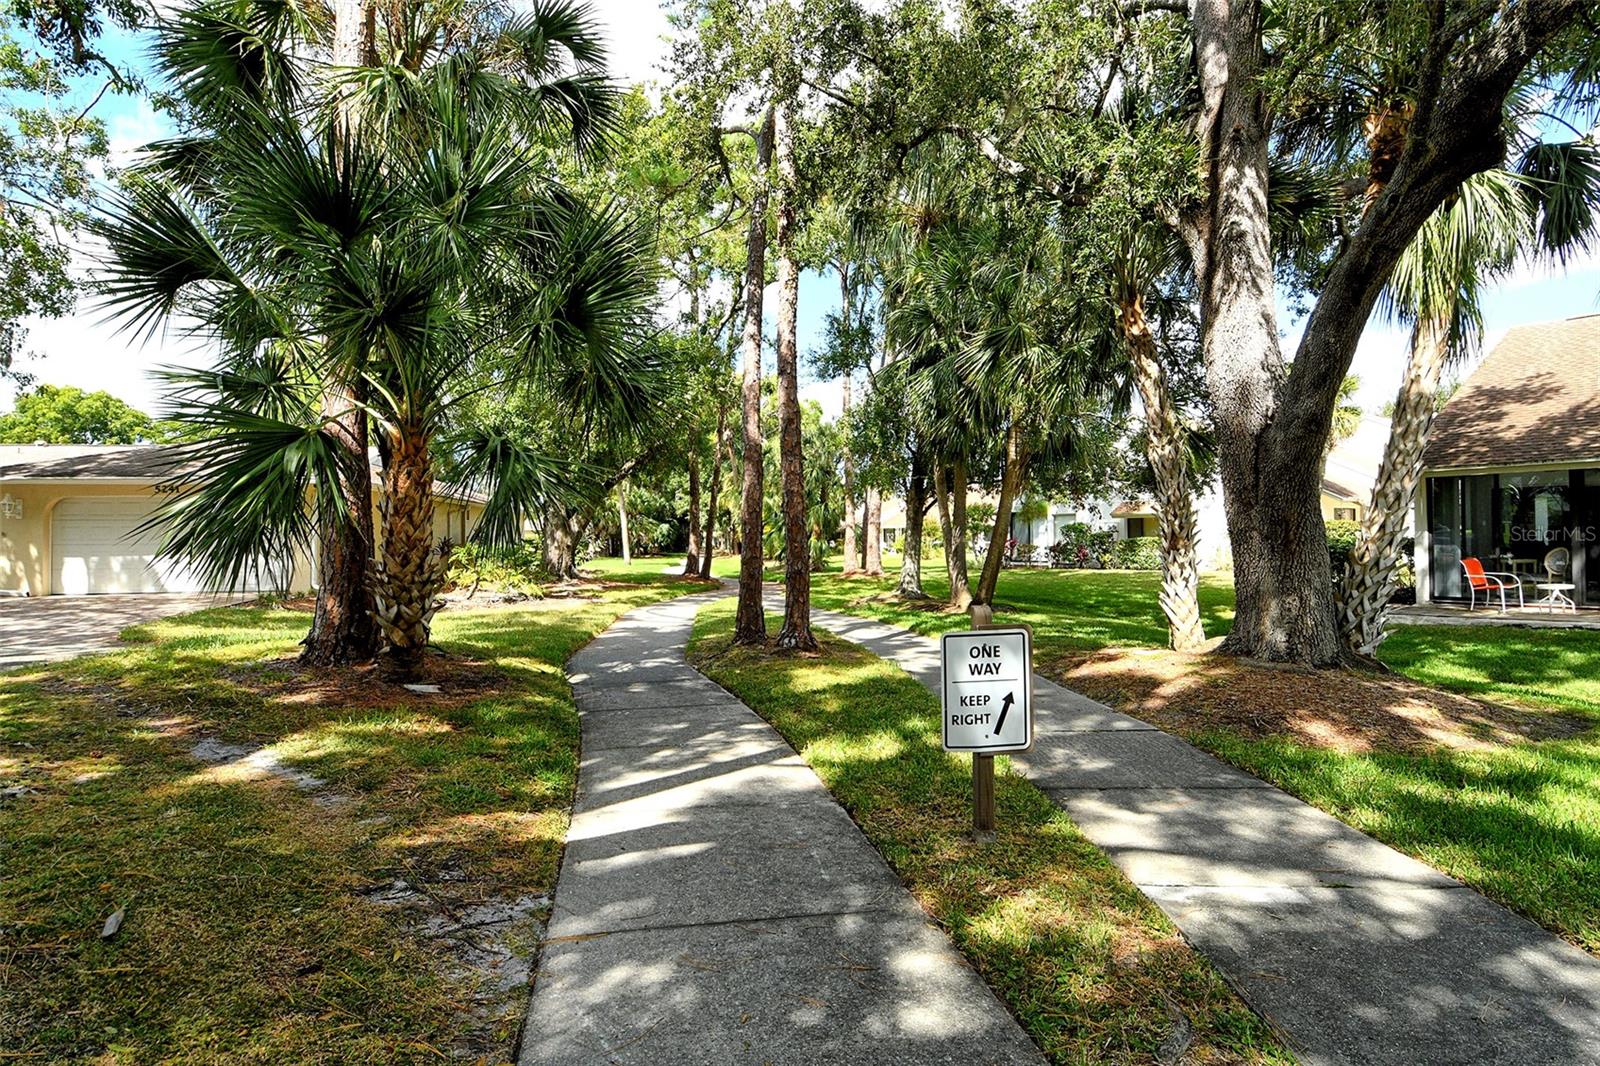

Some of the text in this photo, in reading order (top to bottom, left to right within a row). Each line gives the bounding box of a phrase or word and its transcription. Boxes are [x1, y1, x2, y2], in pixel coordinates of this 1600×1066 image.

[969, 644, 1001, 659] ONE
[968, 662, 1002, 676] WAY
[960, 695, 991, 707] KEEP
[951, 713, 992, 726] RIGHT
